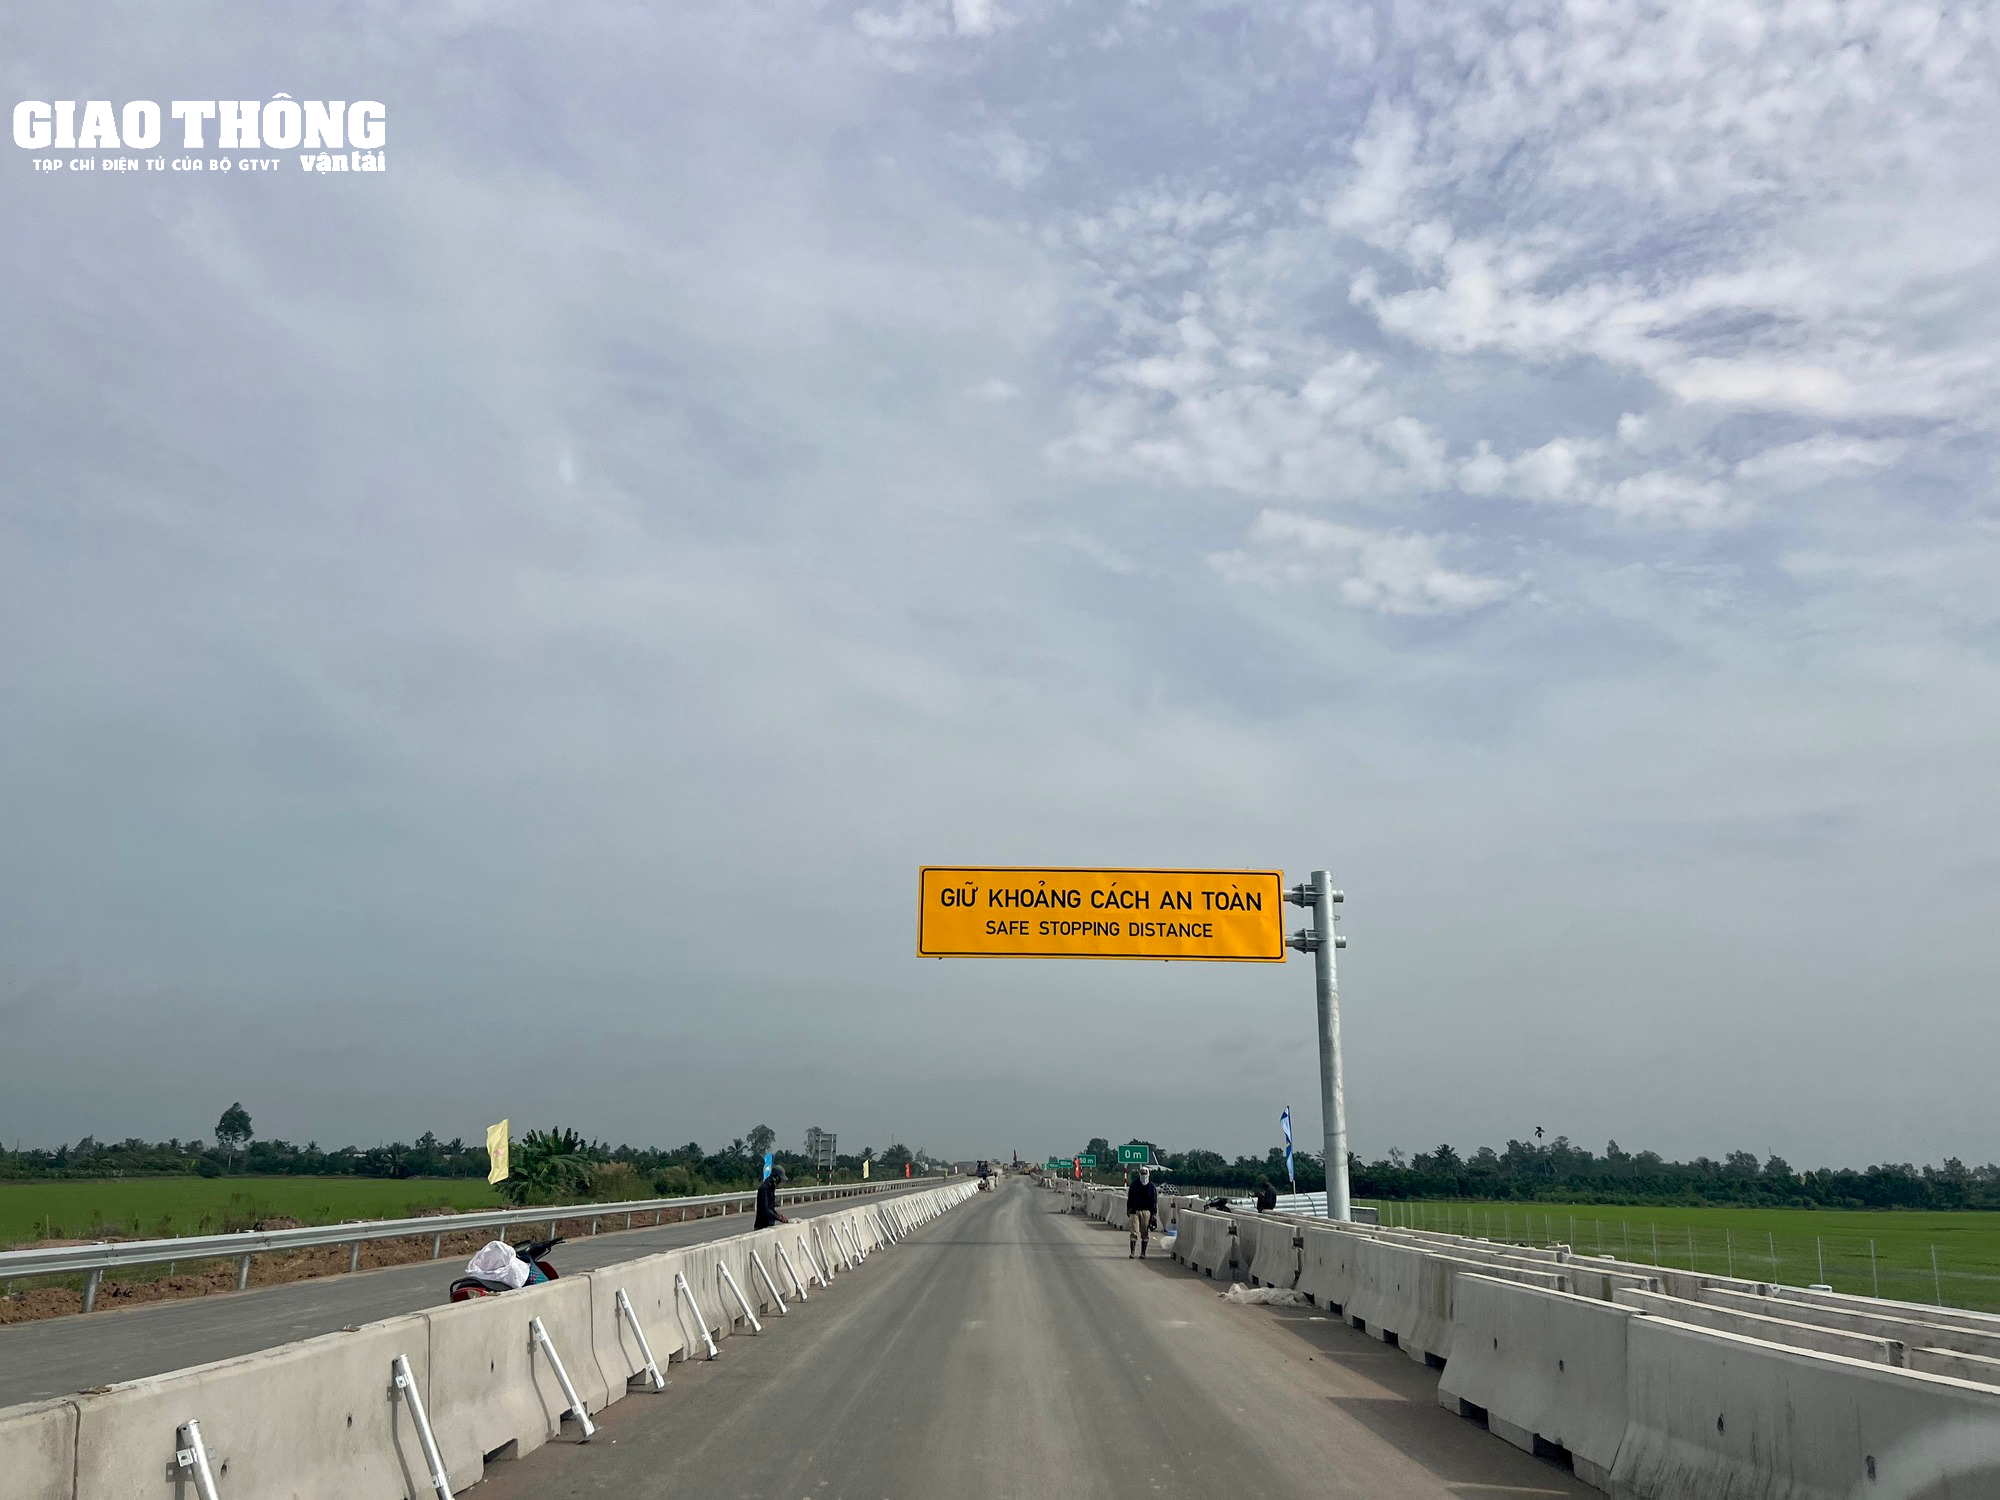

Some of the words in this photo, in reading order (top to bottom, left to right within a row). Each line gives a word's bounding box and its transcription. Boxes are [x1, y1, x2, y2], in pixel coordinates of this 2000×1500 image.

[940, 881, 979, 908] GIỮ
[988, 880, 1082, 909] KHOẢNG
[1090, 881, 1150, 910] CÁCH
[1160, 890, 1192, 911] AN
[1201, 884, 1262, 912] TOÀN
[985, 920, 1030, 936] SAFE
[1039, 921, 1120, 937] STOPPING
[1128, 922, 1213, 938] DISTANCE
[1124, 1150, 1130, 1158] 0
